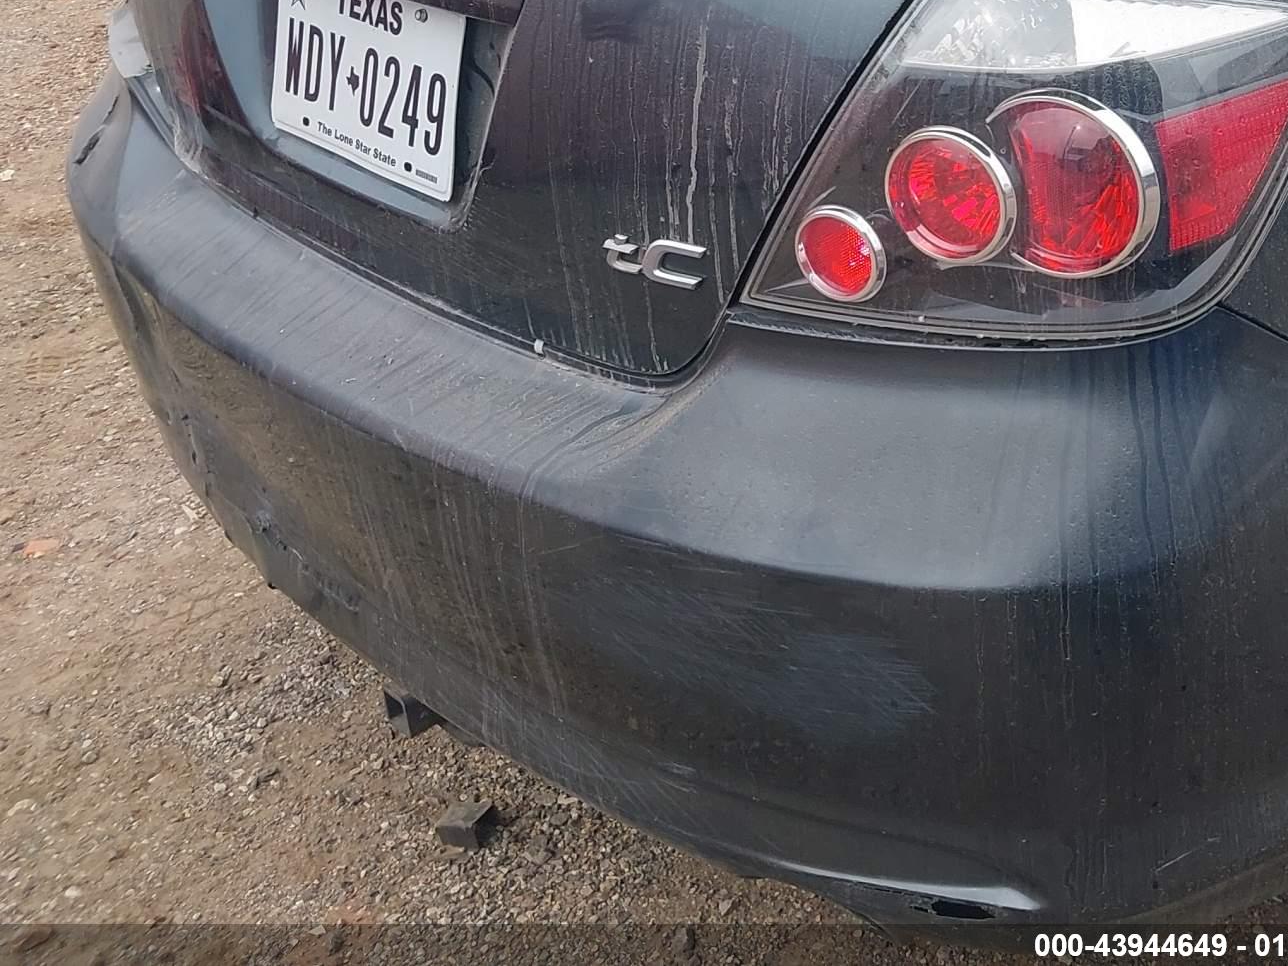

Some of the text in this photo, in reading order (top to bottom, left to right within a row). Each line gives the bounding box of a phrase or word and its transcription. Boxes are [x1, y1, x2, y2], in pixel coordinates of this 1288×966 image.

[317, 121, 397, 167] The Lone Star State
